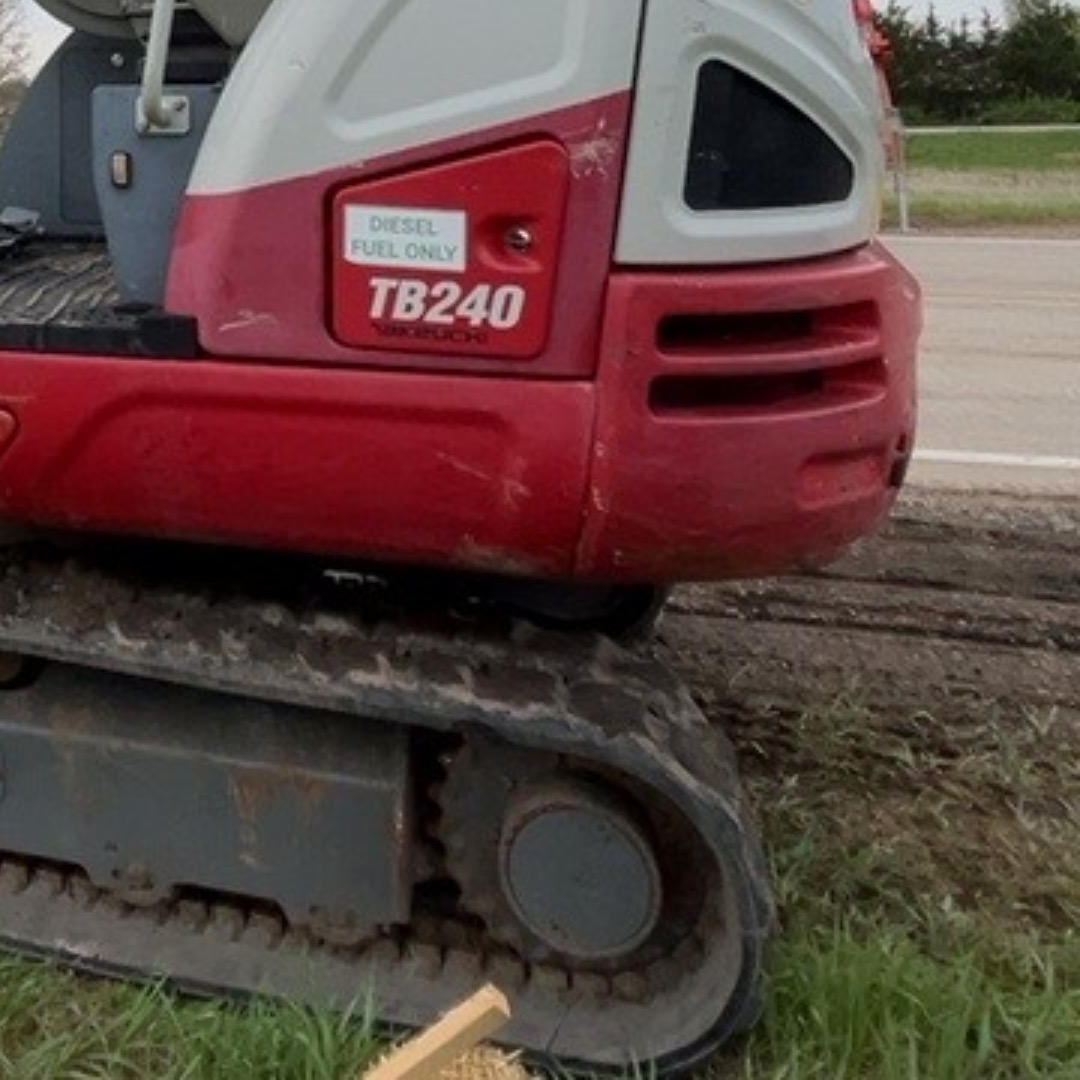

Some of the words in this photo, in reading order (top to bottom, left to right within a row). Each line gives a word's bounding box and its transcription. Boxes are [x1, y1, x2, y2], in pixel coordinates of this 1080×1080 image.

[370, 216, 439, 235] DIESEL
[351, 239, 399, 258] FUEL
[405, 242, 458, 262] ONLY
[369, 277, 526, 330] TB240
